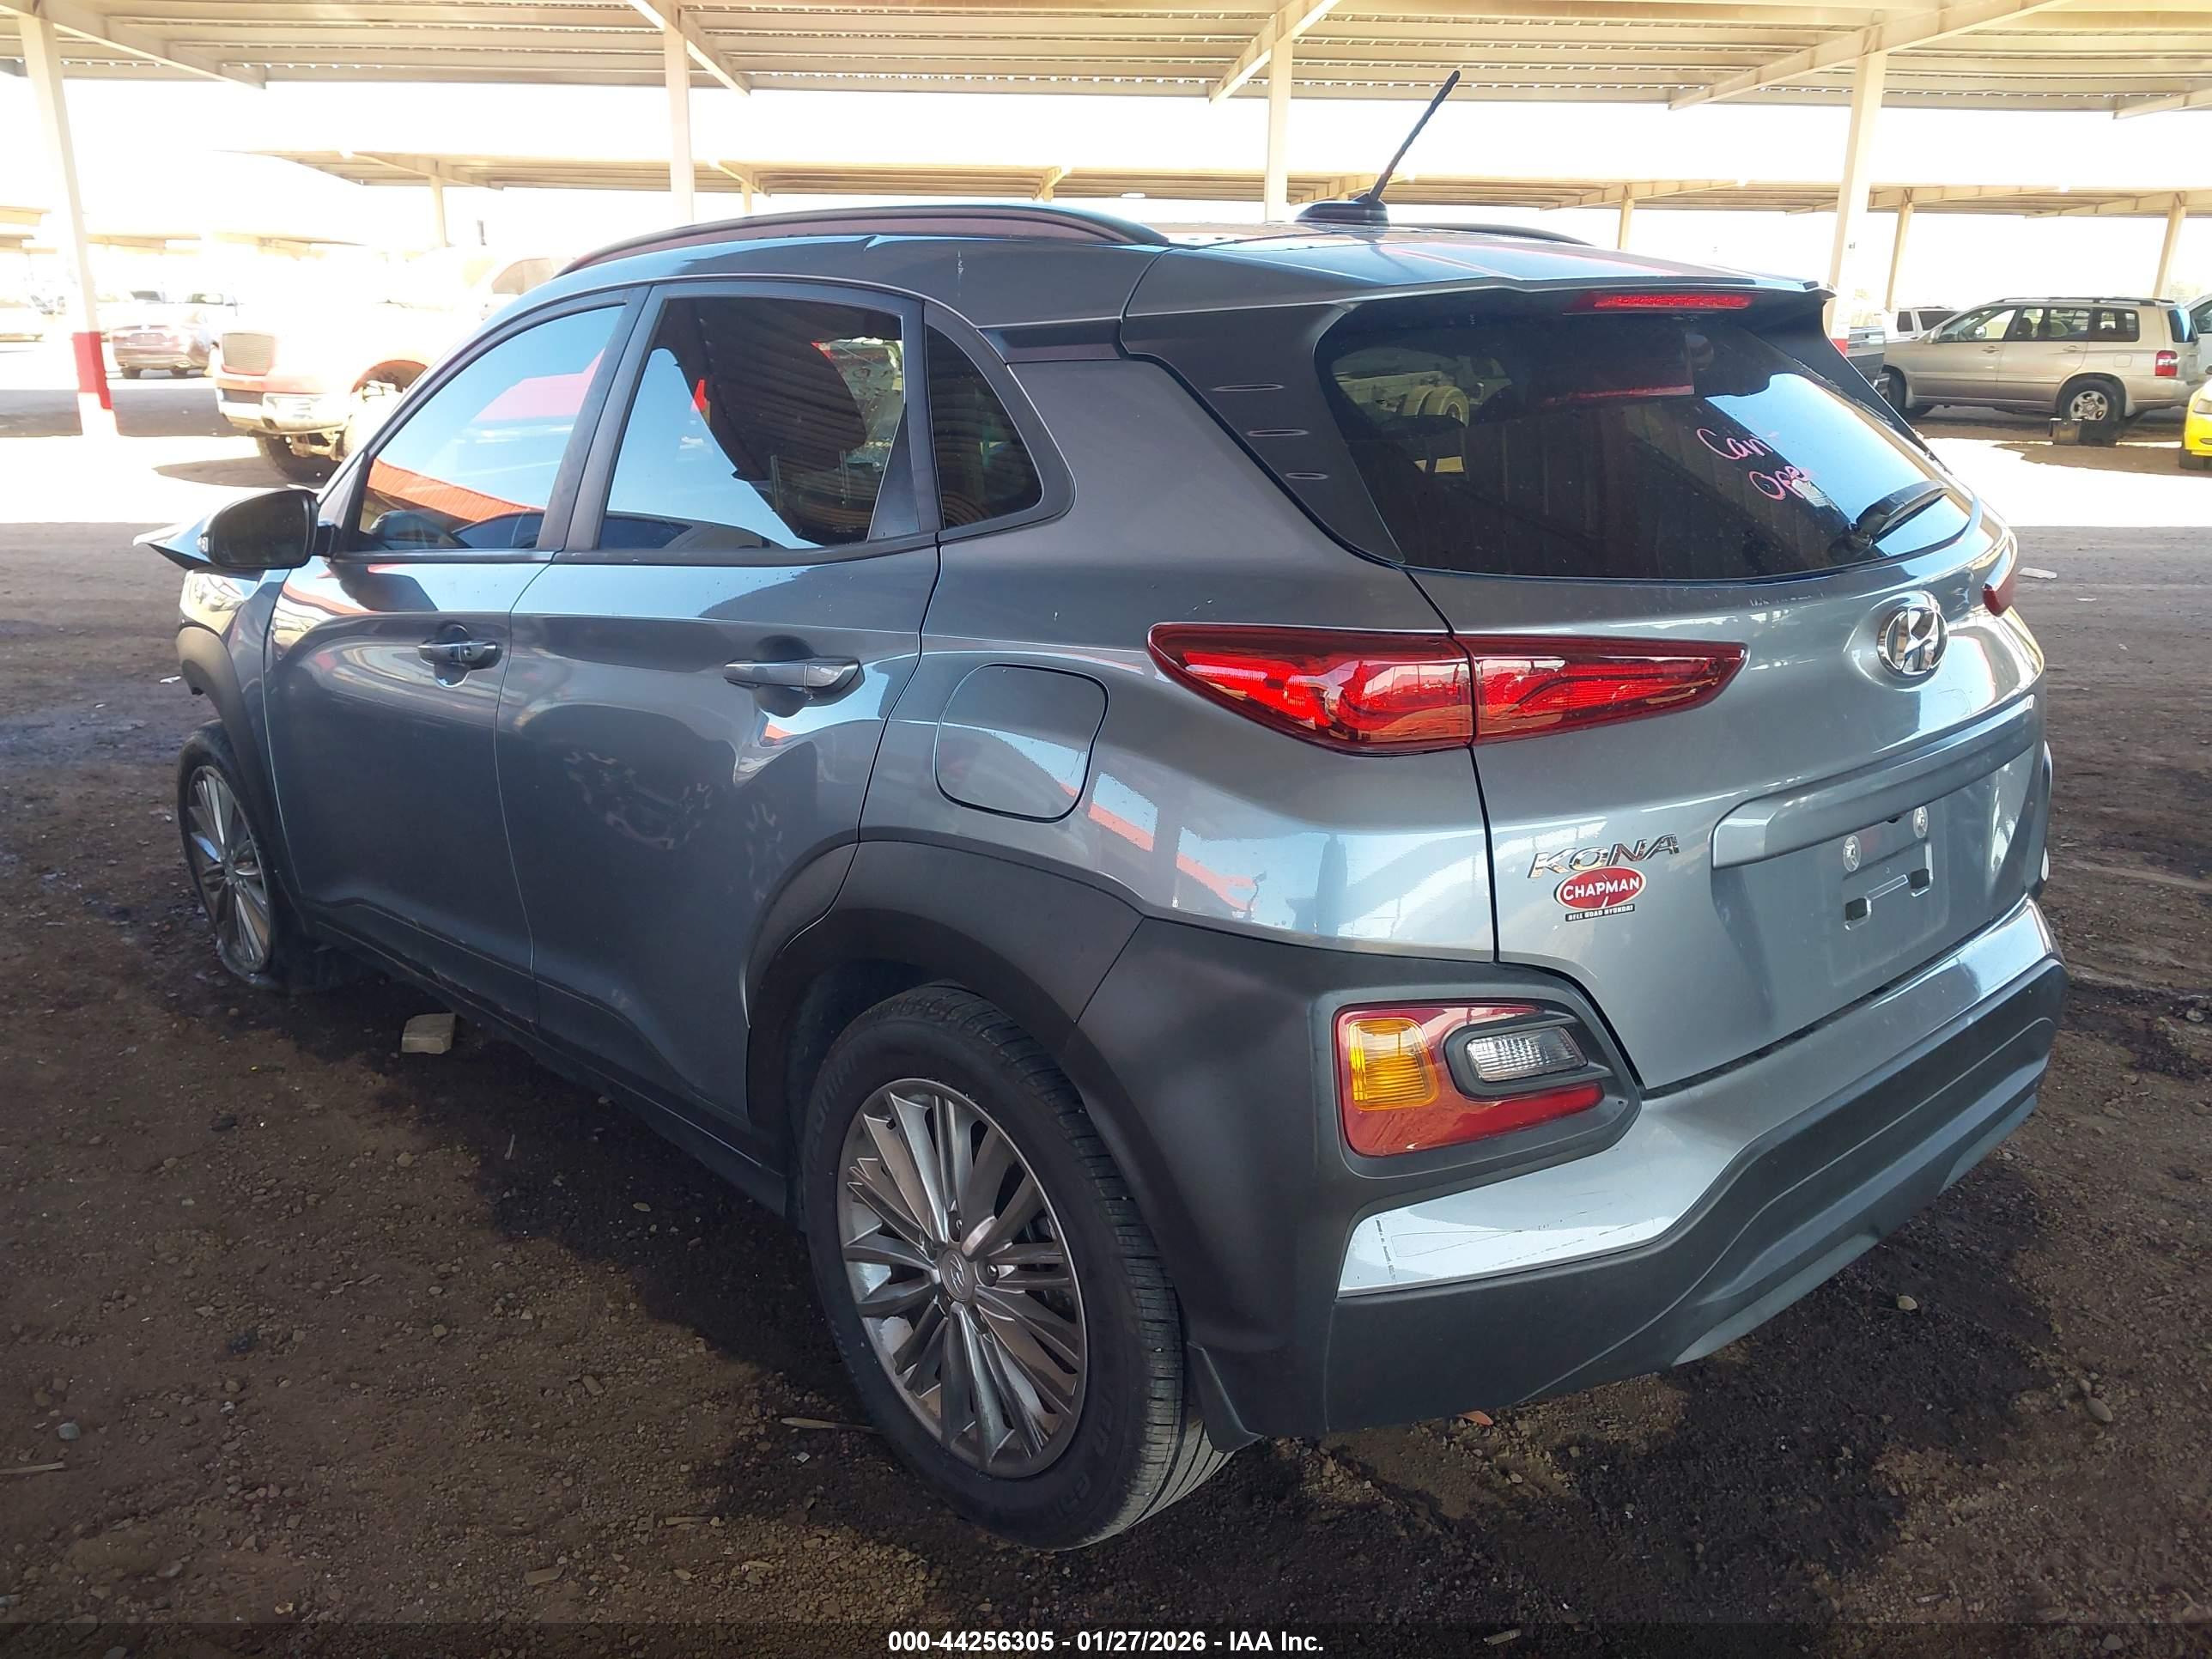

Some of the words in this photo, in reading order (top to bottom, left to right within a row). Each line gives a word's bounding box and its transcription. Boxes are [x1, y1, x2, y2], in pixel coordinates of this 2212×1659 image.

[1527, 833, 1680, 878] KONA
[1562, 876, 1640, 902] CHAPMAN
[1567, 913, 1584, 921] BELL
[1604, 904, 1634, 915] HYUNDAI
